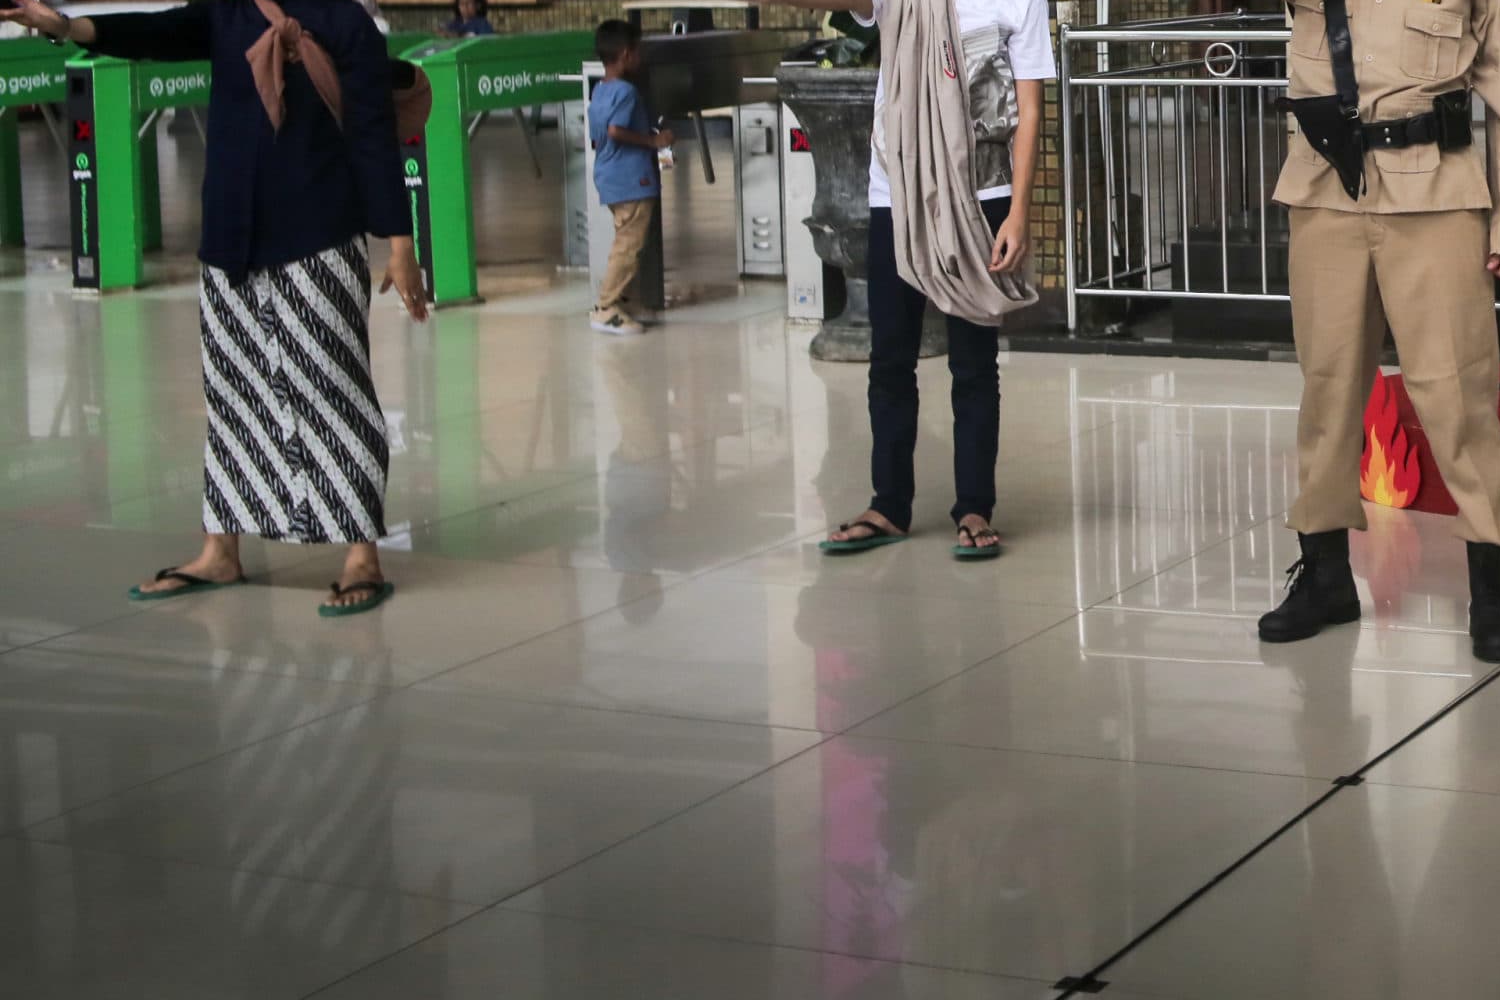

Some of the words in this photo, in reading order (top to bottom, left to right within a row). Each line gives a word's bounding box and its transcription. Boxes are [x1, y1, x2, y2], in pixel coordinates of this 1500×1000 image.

[9, 71, 51, 94] gojek
[166, 72, 206, 96] gojek
[493, 70, 532, 95] gojek
